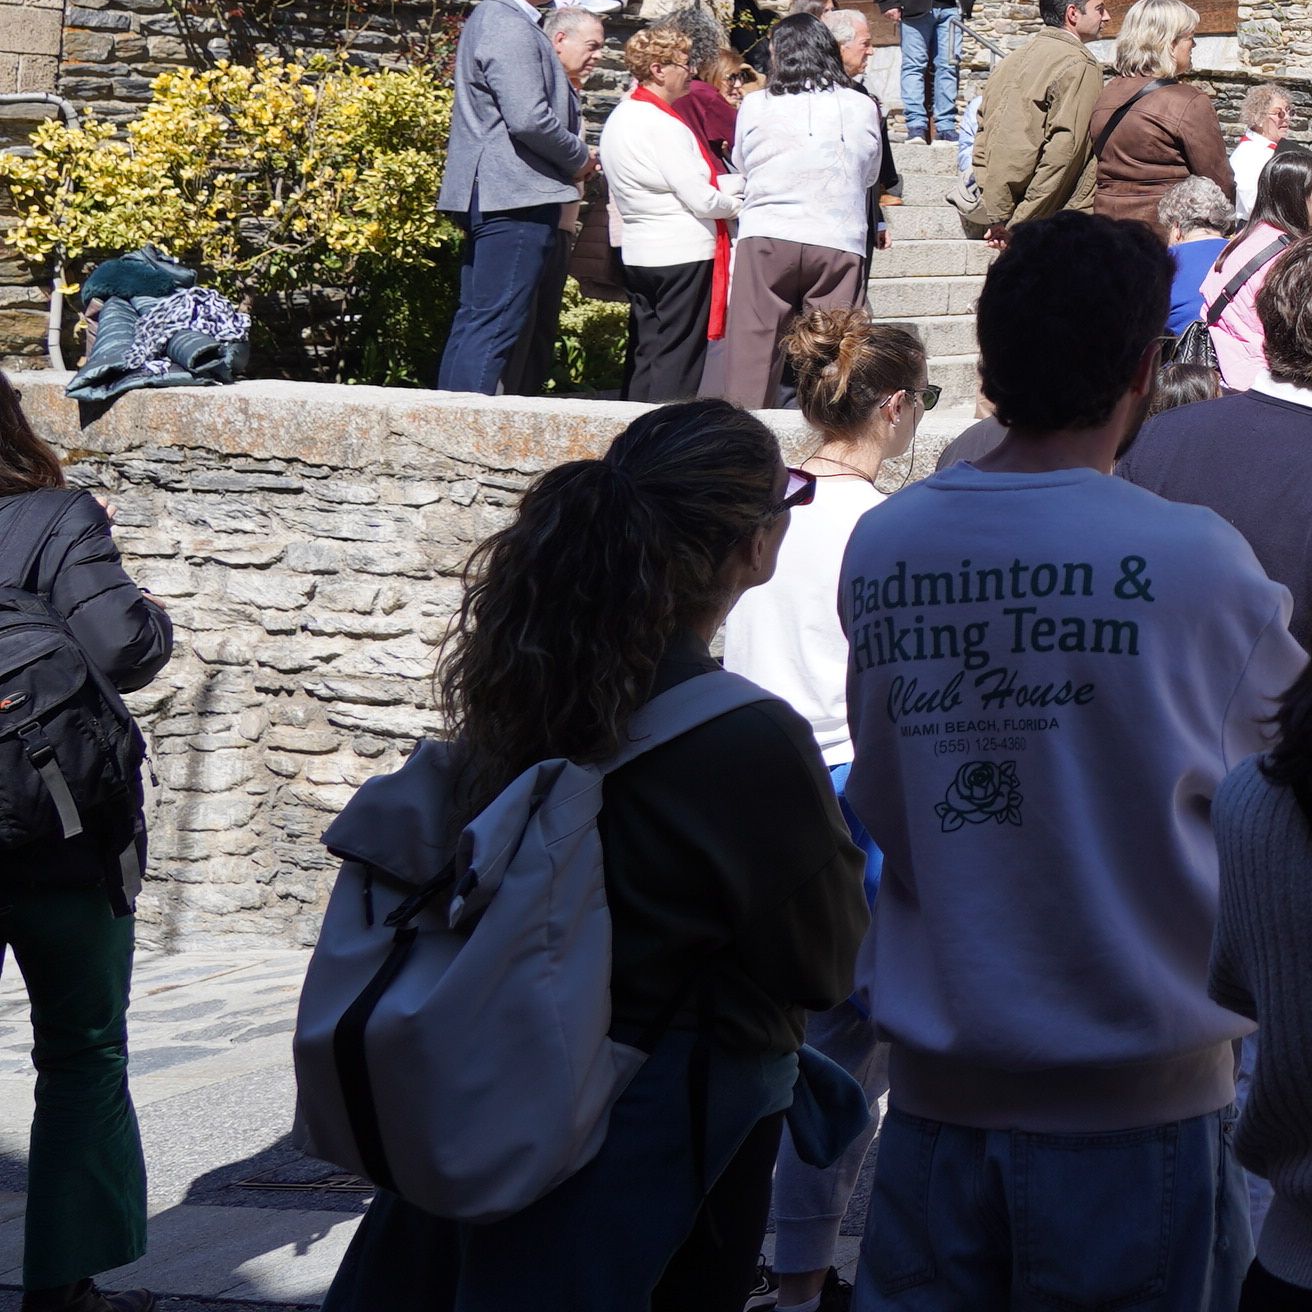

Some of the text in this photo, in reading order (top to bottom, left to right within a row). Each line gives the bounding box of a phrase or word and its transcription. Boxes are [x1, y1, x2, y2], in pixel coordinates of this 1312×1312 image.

[851, 555, 1155, 624] Badminton &
[852, 606, 1140, 674] Hiking Team
[886, 666, 1095, 724] Club House
[900, 717, 1060, 737] MIAMI BEACH, FLORIDA
[934, 738, 970, 756] (555)
